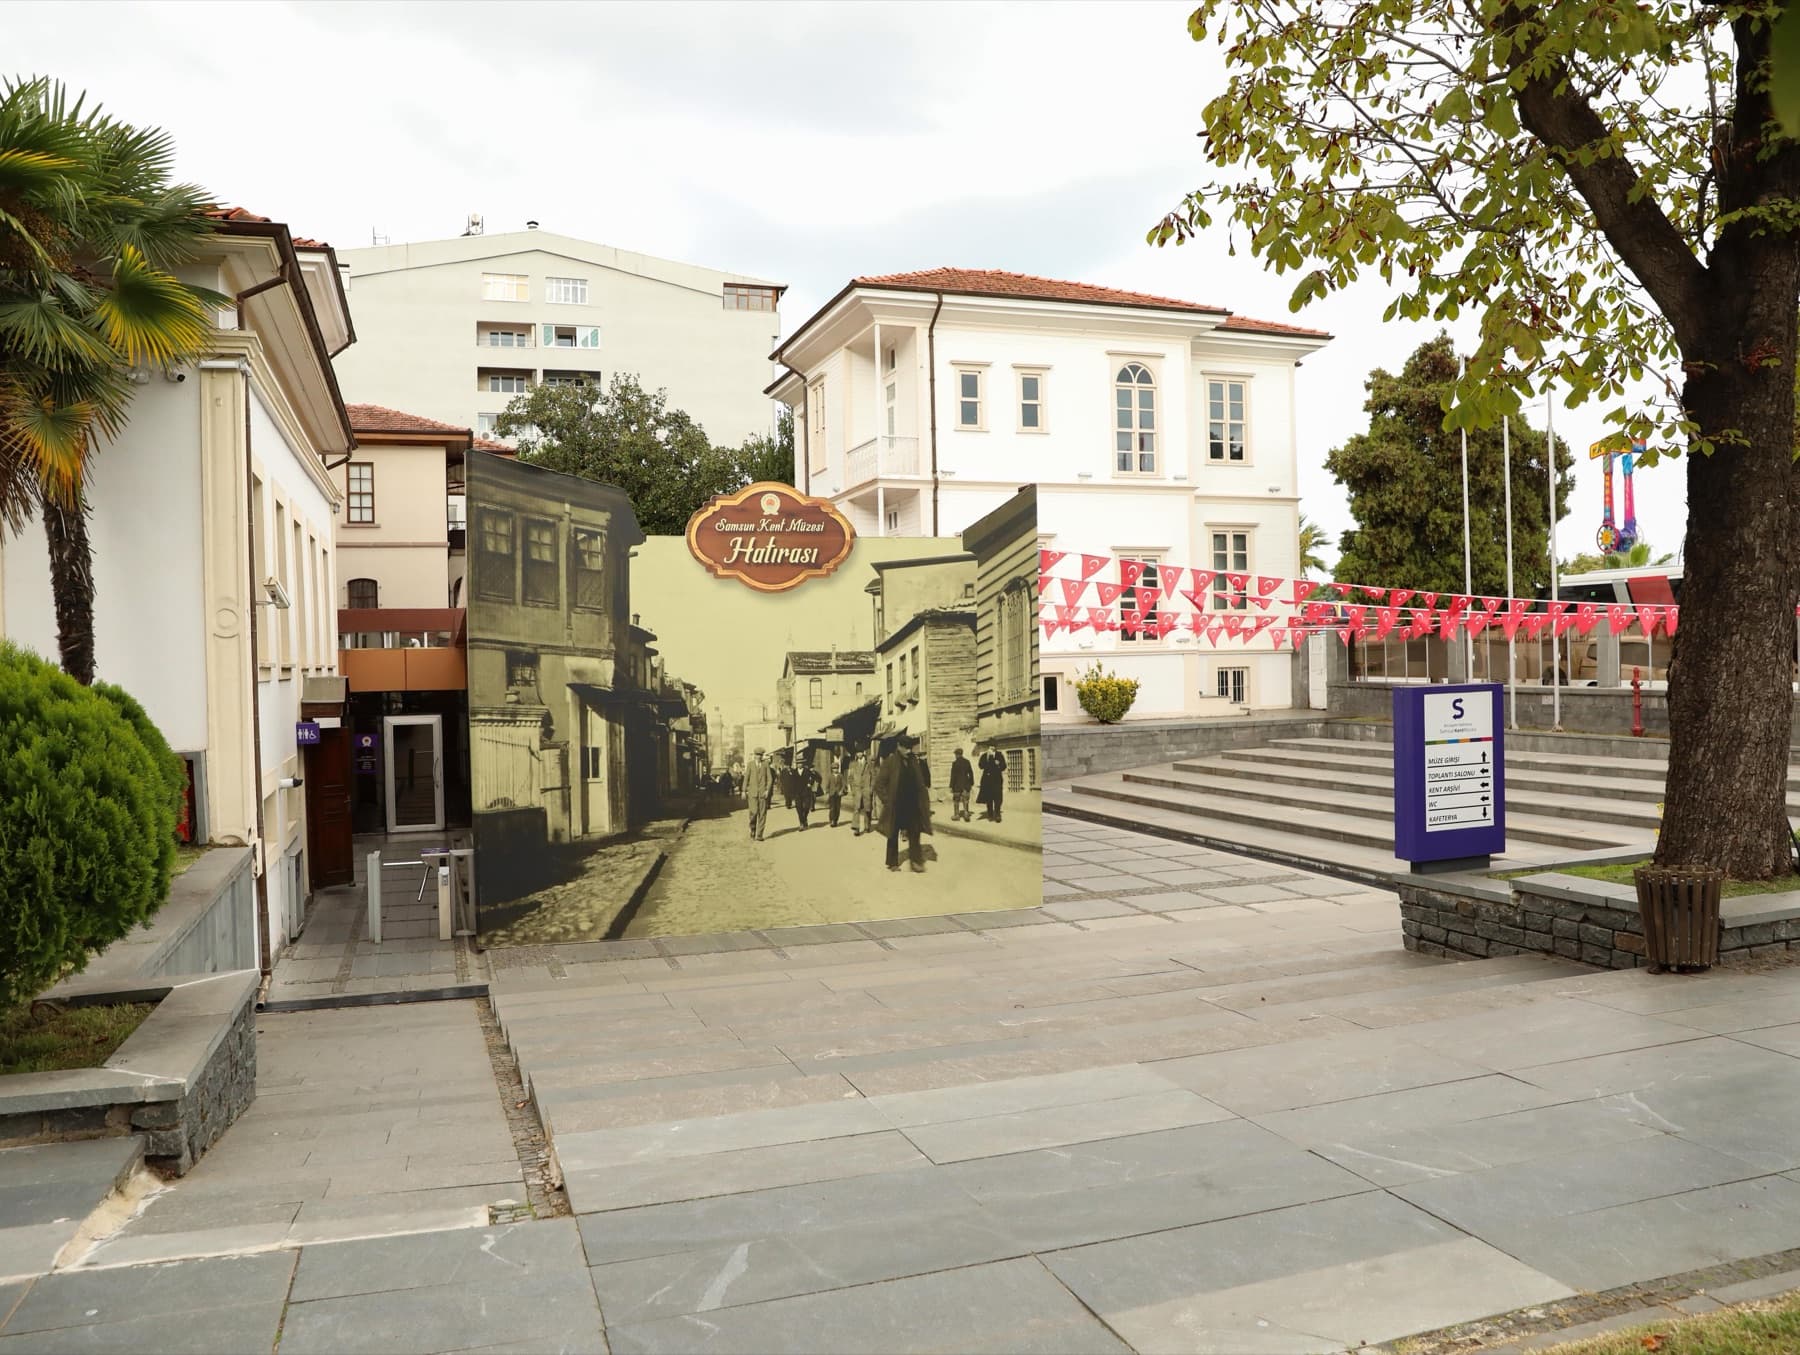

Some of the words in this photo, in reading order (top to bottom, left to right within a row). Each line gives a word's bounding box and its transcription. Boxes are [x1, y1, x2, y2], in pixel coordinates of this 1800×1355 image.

[715, 518, 755, 532] Samsun
[757, 517, 785, 532] Kent
[785, 518, 825, 532] Müzesi
[723, 536, 818, 564] Hatırası
[1454, 770, 1475, 778] SALONU
